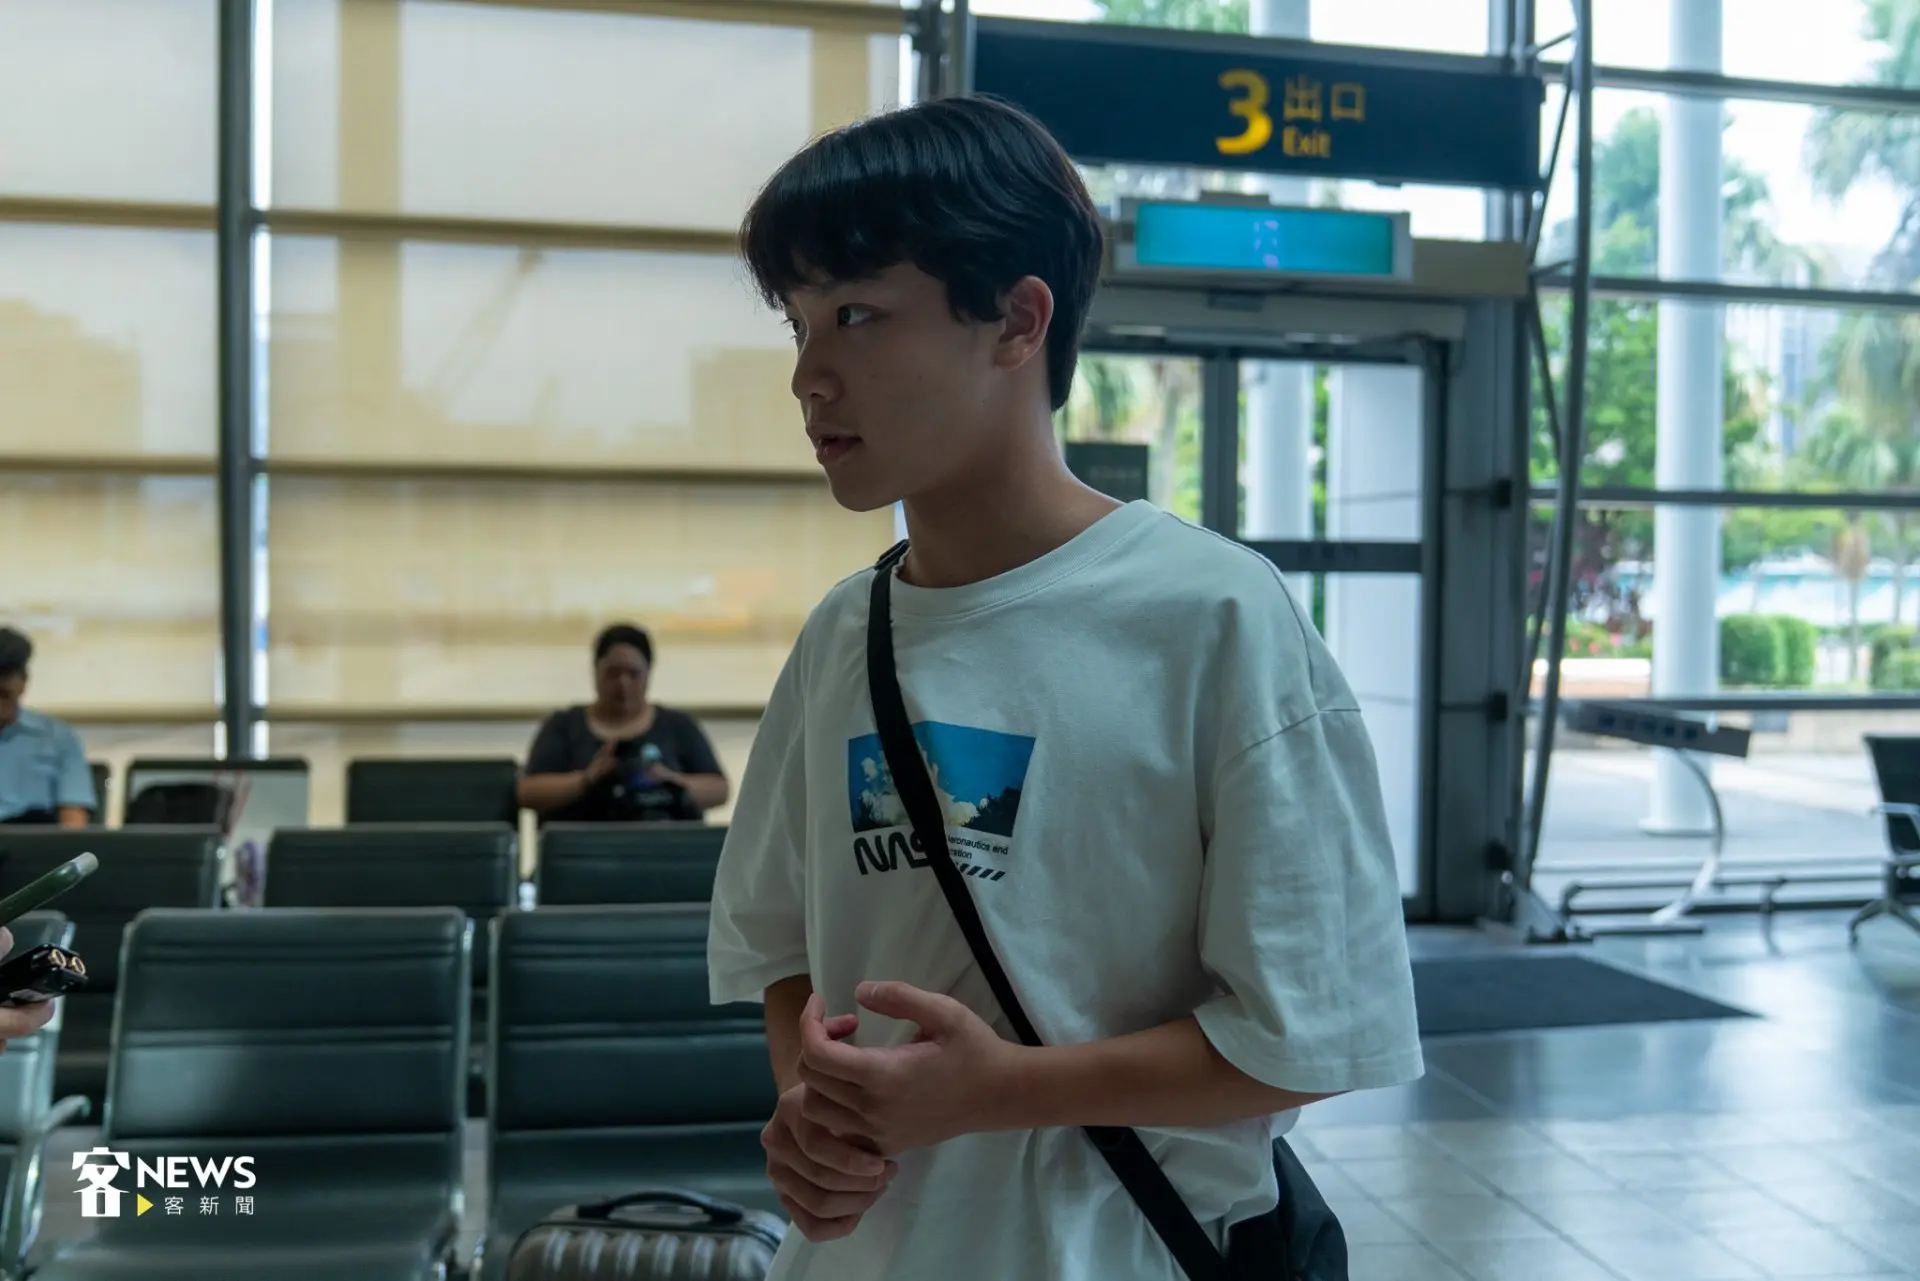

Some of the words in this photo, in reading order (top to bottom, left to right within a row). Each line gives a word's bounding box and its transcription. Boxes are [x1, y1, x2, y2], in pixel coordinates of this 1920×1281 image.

[1216, 68, 1272, 155] 3
[1283, 74, 1366, 122] 出口
[1282, 125, 1331, 158] Exit
